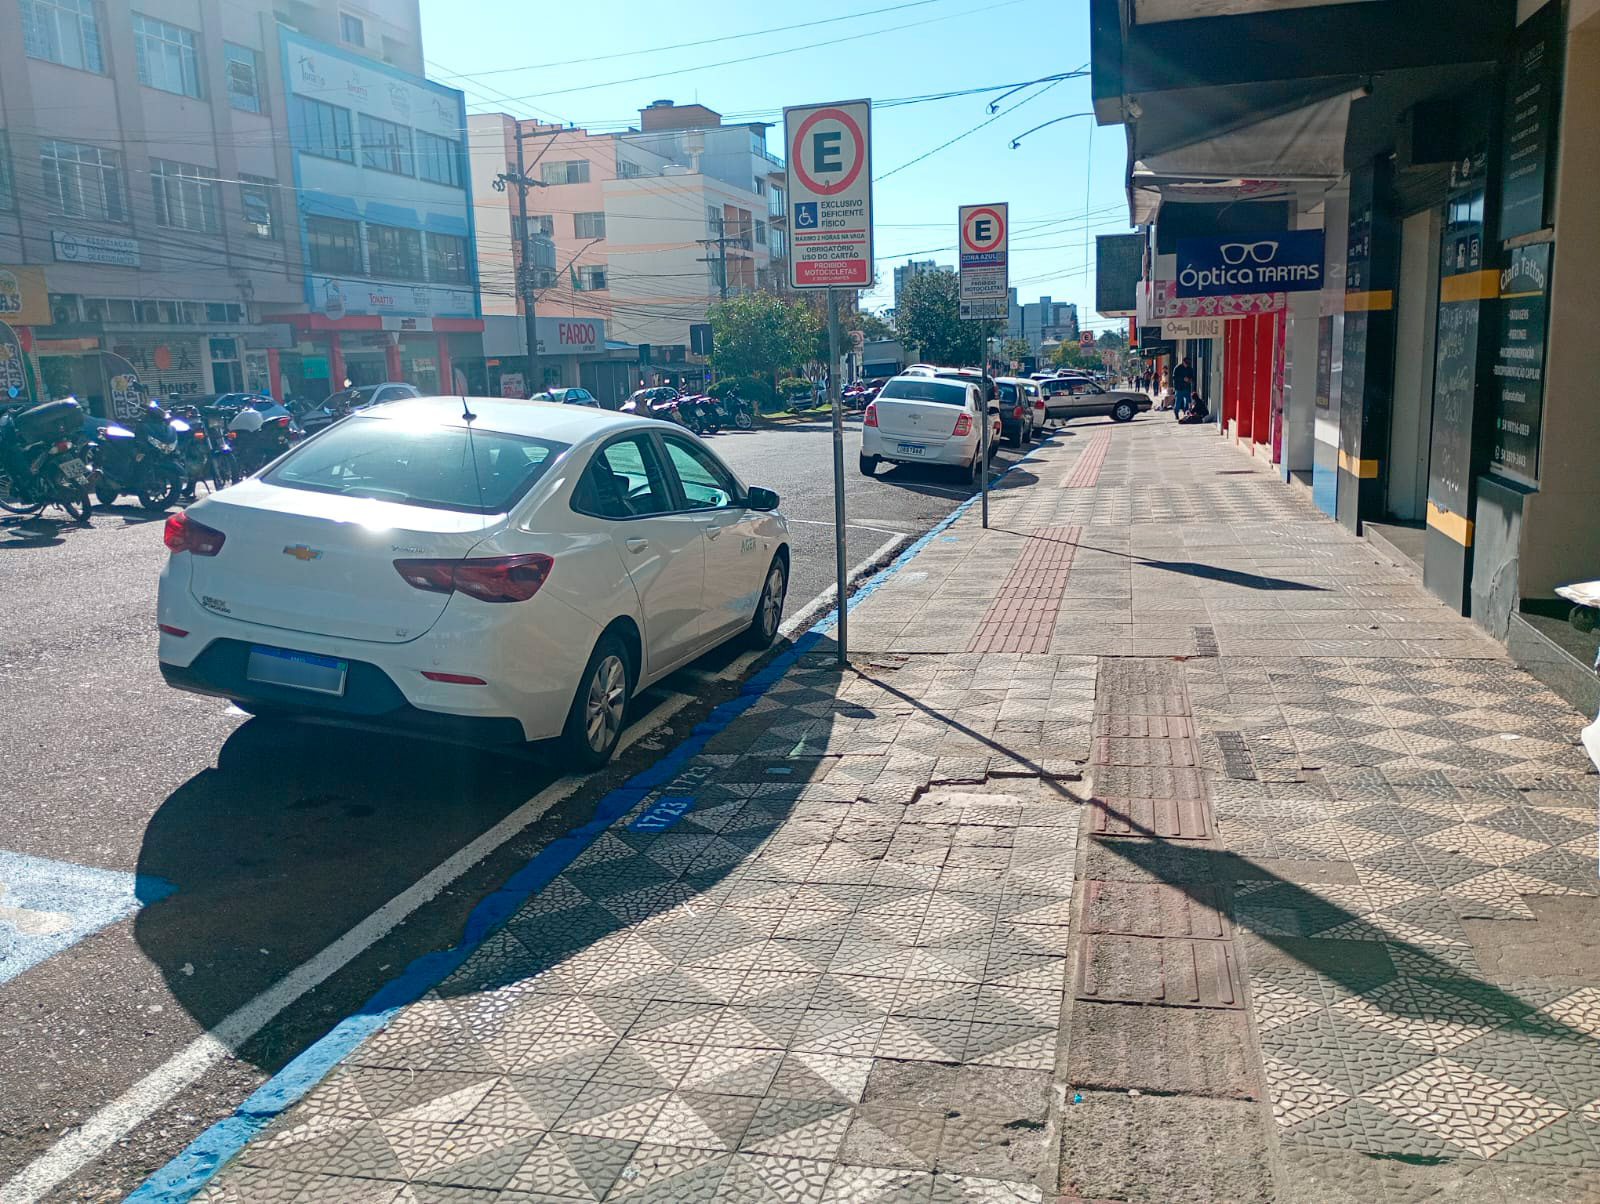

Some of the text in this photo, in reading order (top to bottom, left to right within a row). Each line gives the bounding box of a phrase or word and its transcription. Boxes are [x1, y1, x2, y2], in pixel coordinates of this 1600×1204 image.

[813, 131, 842, 173] E
[821, 199, 863, 209] EXCLUSIVO
[821, 208, 865, 218] DEFICIENTE
[849, 232, 865, 240] VAGA
[975, 219, 992, 242] E
[806, 244, 855, 253] OBRIGATÓRIO
[801, 253, 816, 261] USO
[980, 253, 997, 261] AZUL
[804, 268, 857, 277] MOTOCICLETAS
[1179, 263, 1253, 291] Óptica
[1256, 264, 1320, 283] TARTAS
[1500, 256, 1545, 290] Clara Tattoo
[558, 323, 596, 345] FARDO
[1188, 319, 1220, 335] JUNG
[160, 379, 198, 394] house
[665, 766, 715, 790] 1723
[636, 802, 688, 828] 1723
